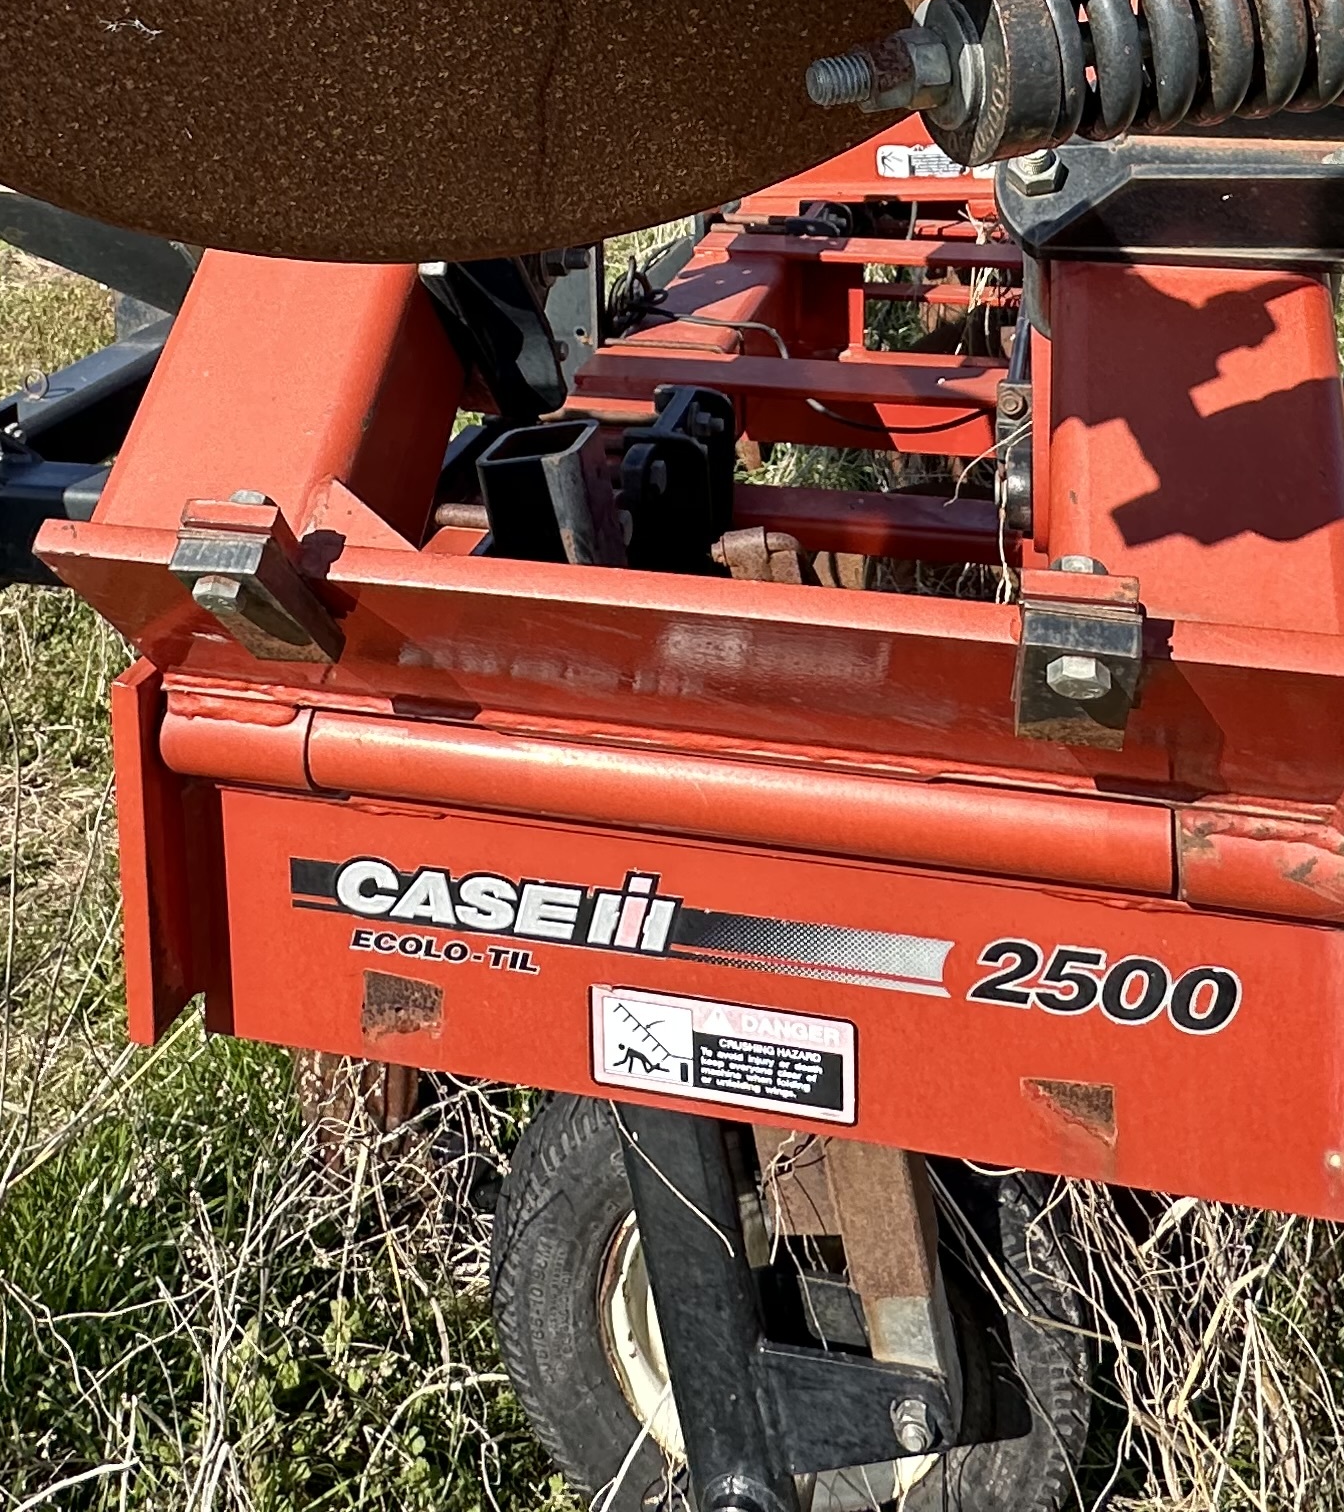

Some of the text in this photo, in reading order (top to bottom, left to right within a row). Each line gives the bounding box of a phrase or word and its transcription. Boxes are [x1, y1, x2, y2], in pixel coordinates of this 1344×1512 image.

[337, 861, 582, 940] CASE
[351, 929, 540, 974] ECOLO-TIL
[966, 938, 1243, 1035] 2500
[741, 1014, 840, 1047] DANGER
[718, 1038, 821, 1063] CRUSHING HAZARD
[747, 1054, 775, 1068] injury
